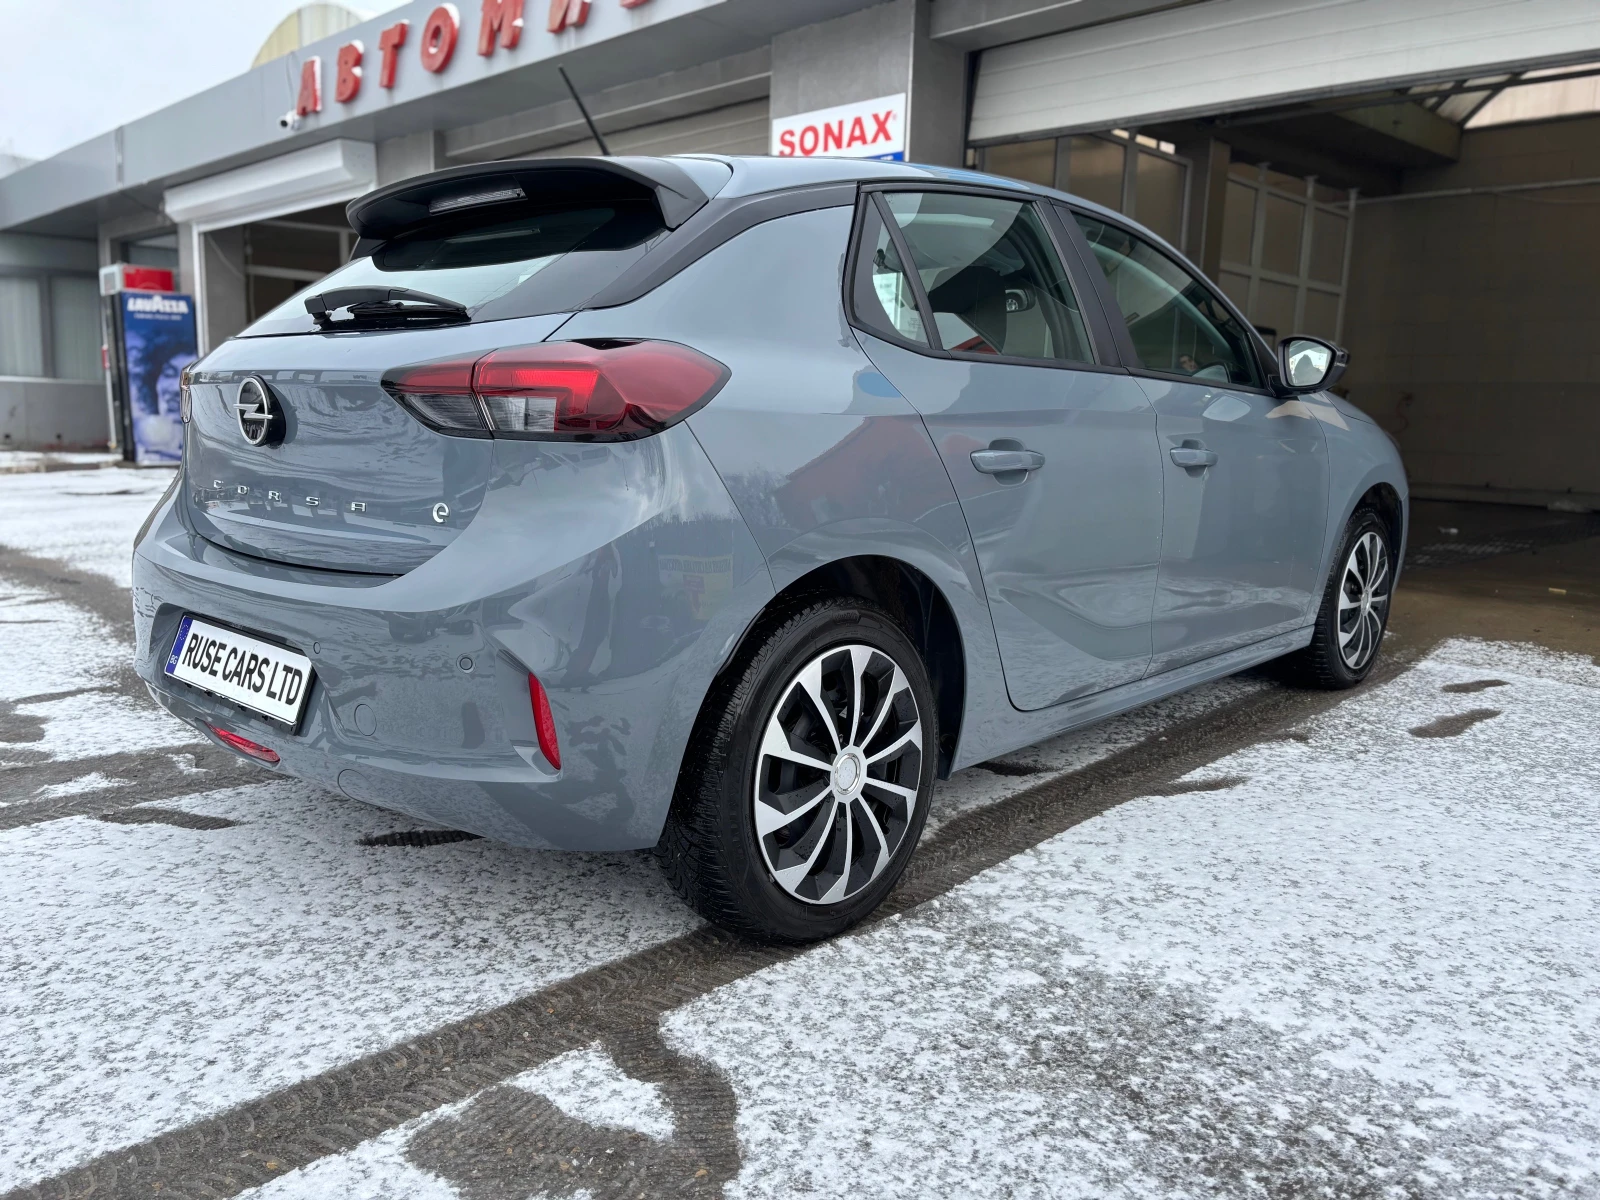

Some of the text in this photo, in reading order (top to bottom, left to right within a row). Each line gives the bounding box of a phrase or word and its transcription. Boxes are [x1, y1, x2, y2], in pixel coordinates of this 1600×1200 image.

[127, 295, 189, 314] LAVAZZA
[213, 479, 367, 512] CORSA
[169, 654, 179, 665] BG
[181, 633, 303, 706] RUSE CARS LTD
